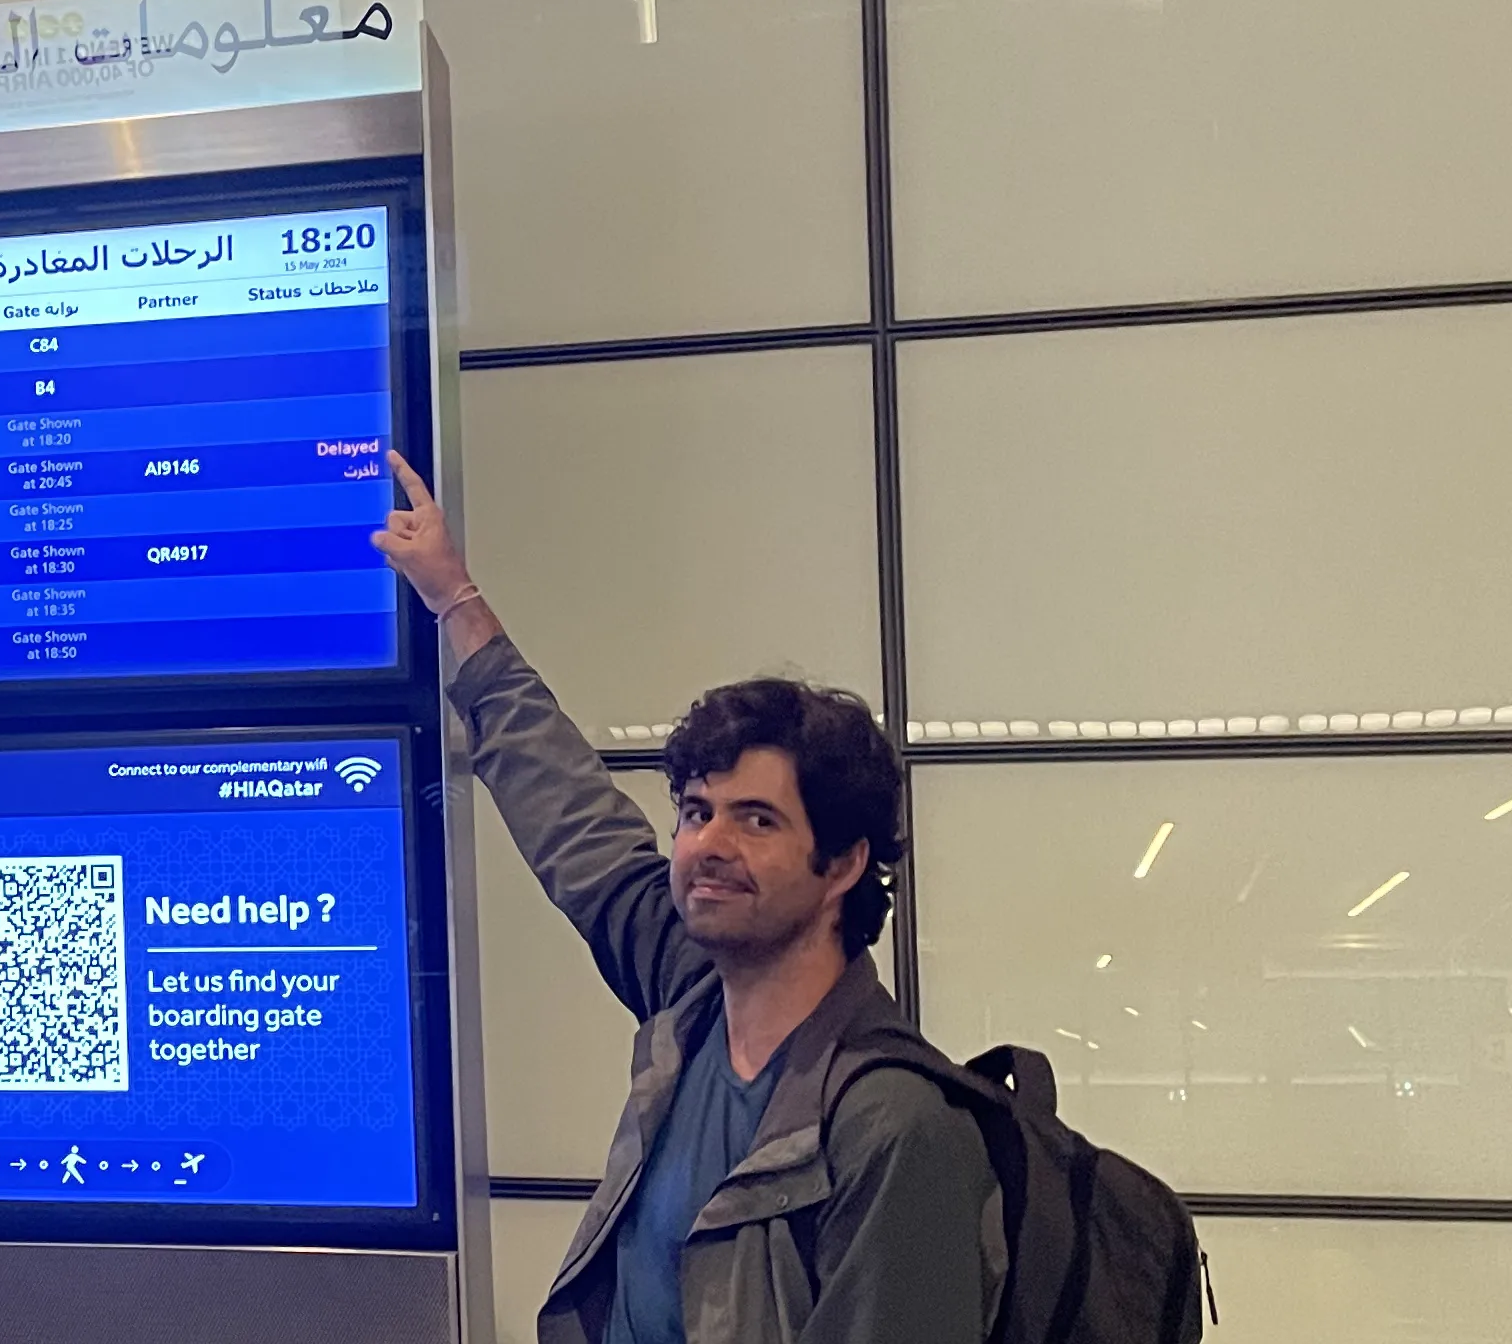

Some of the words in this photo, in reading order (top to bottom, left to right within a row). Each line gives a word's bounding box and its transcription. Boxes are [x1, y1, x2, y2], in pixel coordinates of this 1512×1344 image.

[282, 224, 375, 254] 18:20
[122, 235, 232, 269] الرحلات
[300, 261, 324, 273] May
[323, 258, 346, 268] 2024
[139, 296, 198, 309] Partner
[249, 288, 301, 301] Status
[4, 306, 39, 318] Gate
[30, 338, 58, 352] C84
[36, 380, 55, 395] B4
[317, 439, 378, 457] Delayed
[8, 462, 37, 474] Gate
[41, 460, 82, 472] Shown
[145, 459, 199, 476] AI9146
[23, 479, 35, 489] at
[39, 476, 72, 488] 20:45
[148, 545, 208, 564] QR4917
[109, 764, 162, 776] Connect
[164, 764, 177, 775] to
[180, 765, 201, 774] our
[203, 761, 303, 776] complementary
[305, 758, 327, 771] wifi
[219, 779, 323, 797] #HIAQatar
[146, 896, 230, 924] Need
[239, 895, 309, 930] help
[317, 893, 335, 922] ?
[148, 969, 184, 995] Let
[195, 976, 223, 992] us
[228, 970, 275, 992] find
[281, 975, 339, 998] your
[149, 1004, 259, 1032] boarding
[265, 1005, 322, 1032] gate
[149, 1038, 260, 1066] together
